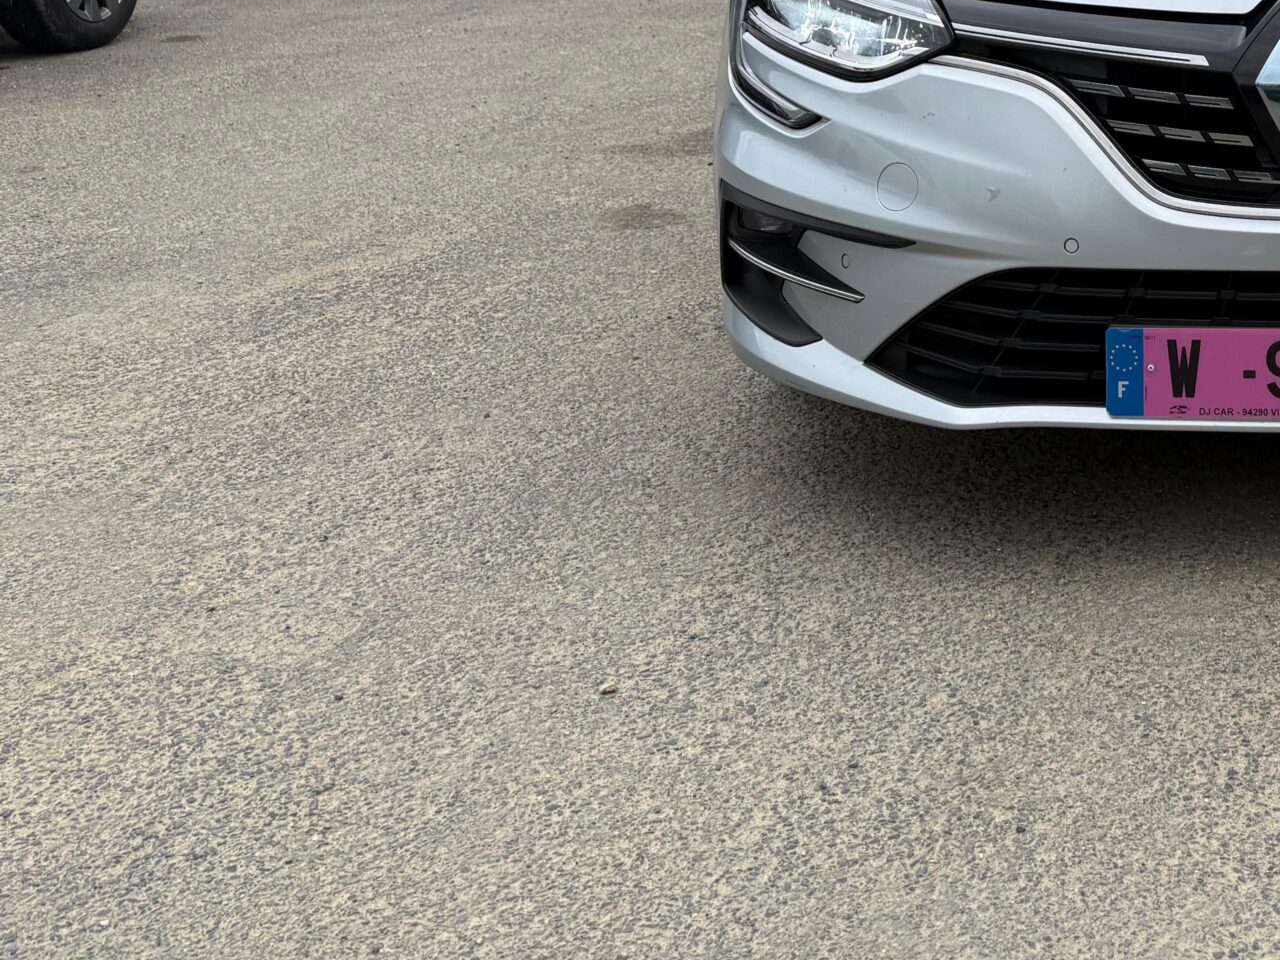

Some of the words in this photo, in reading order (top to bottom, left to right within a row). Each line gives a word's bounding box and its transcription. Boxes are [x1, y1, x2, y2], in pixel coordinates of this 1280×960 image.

[1167, 339, 1201, 398] W
[1118, 381, 1129, 398] F
[1199, 407, 1211, 416] DJ
[1213, 407, 1234, 416] CAR
[1242, 408, 1268, 416] 94290
